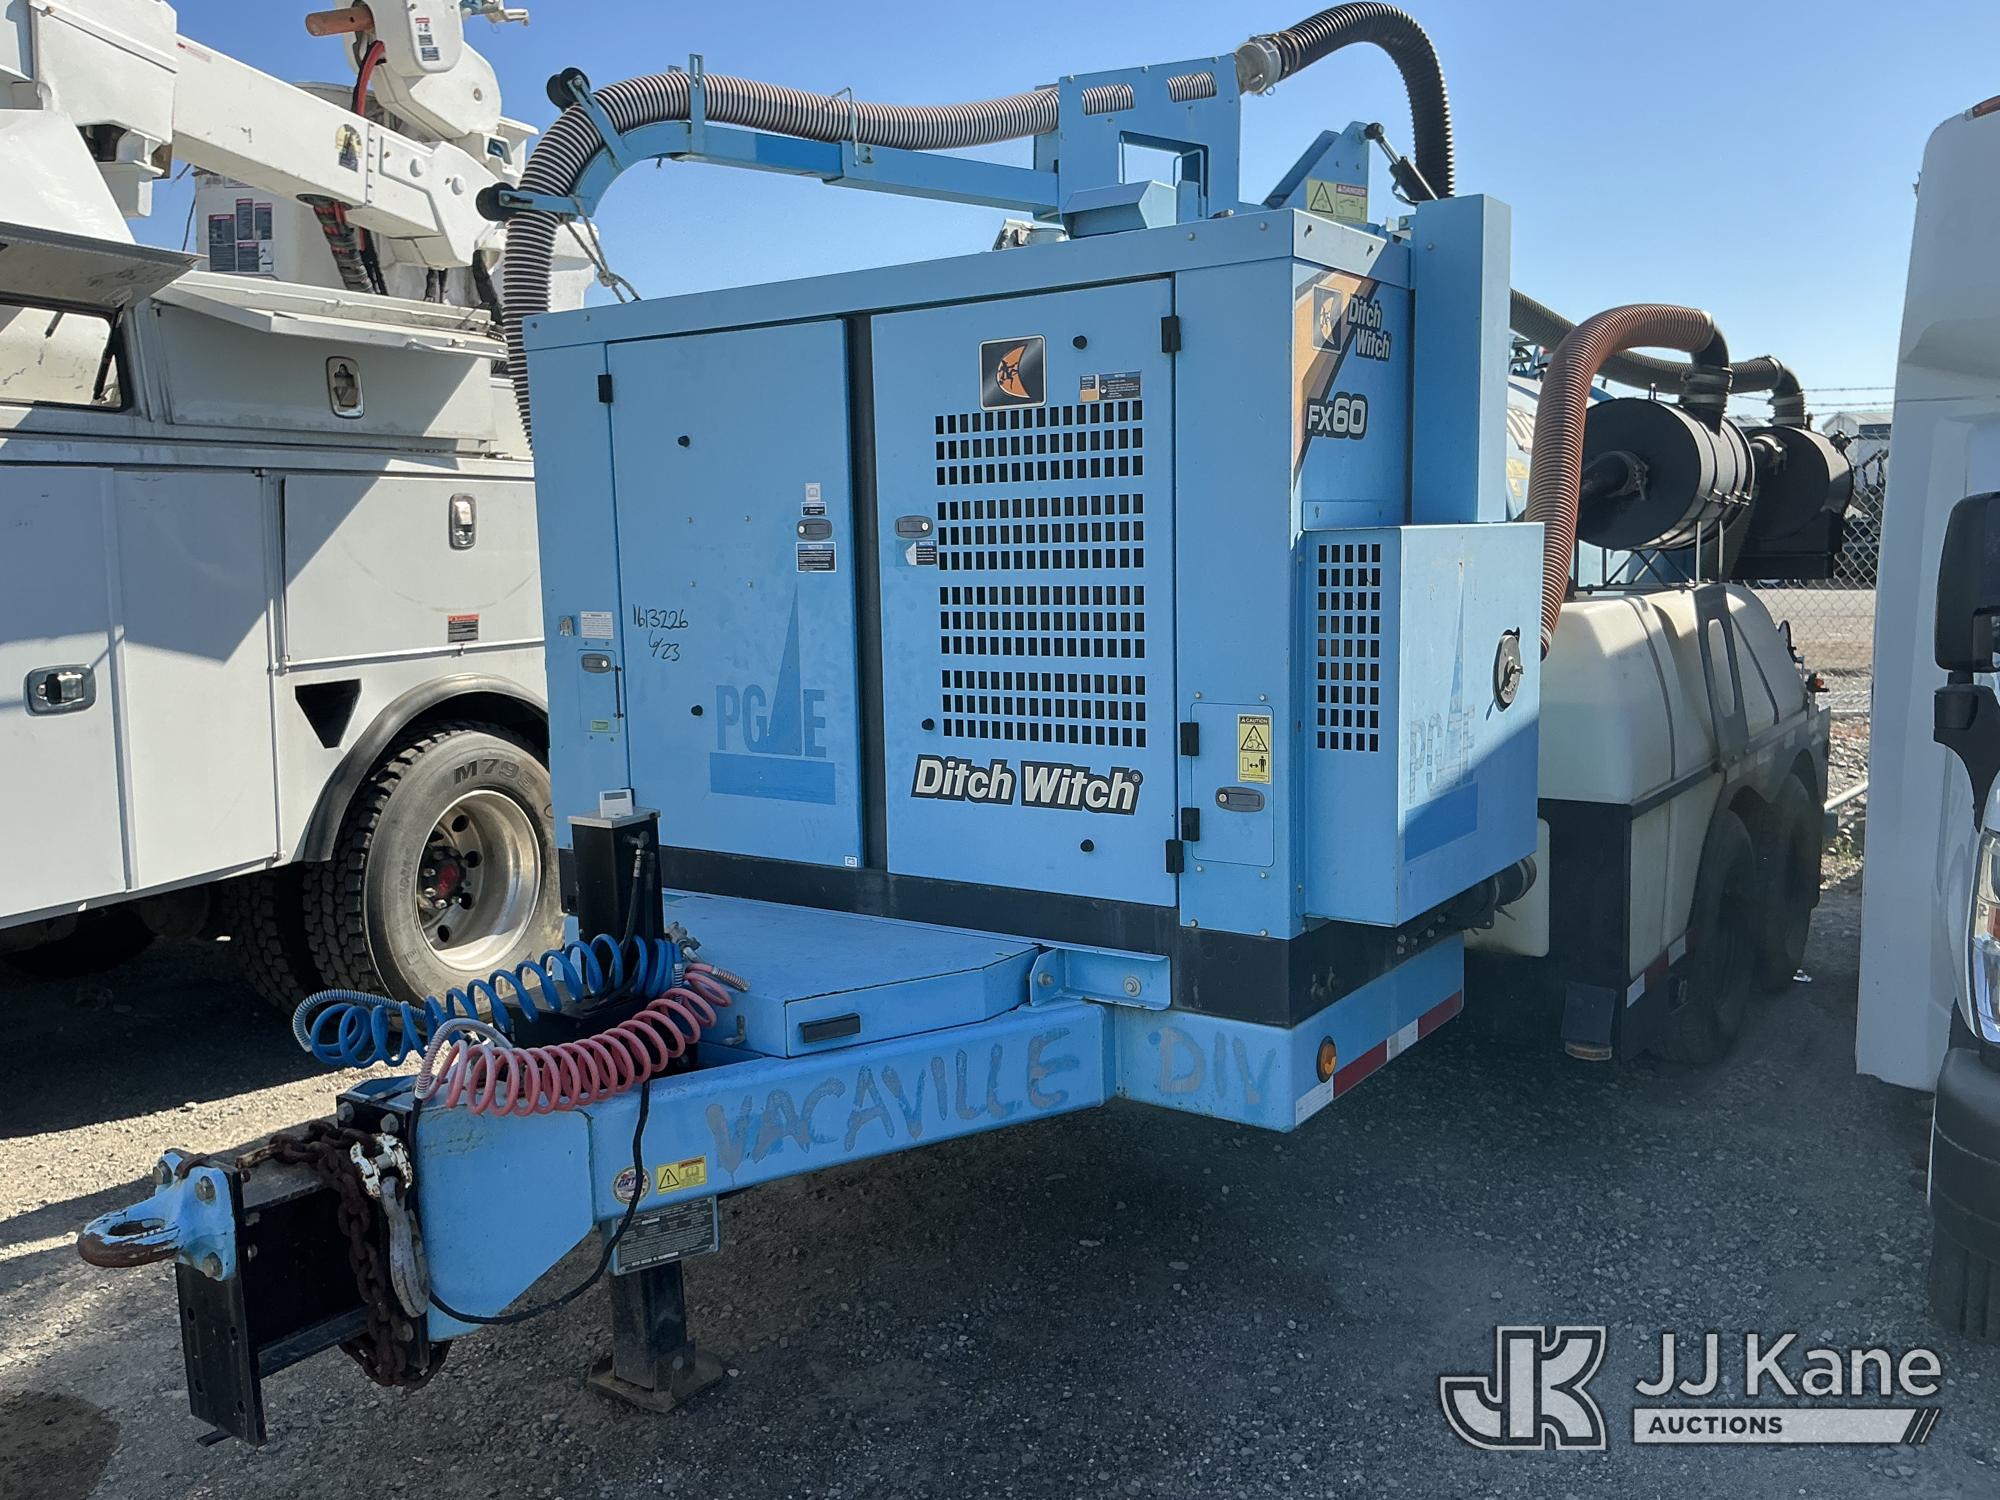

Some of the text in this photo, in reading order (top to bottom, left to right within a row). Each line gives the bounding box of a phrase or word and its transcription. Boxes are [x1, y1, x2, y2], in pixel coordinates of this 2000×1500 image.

[1347, 296, 1382, 329] Ditch
[1307, 398, 1366, 434] FX60
[632, 603, 689, 630] 1613226
[915, 759, 1014, 801] Ditch
[705, 1026, 1277, 1184] VACAVILLE DIV
